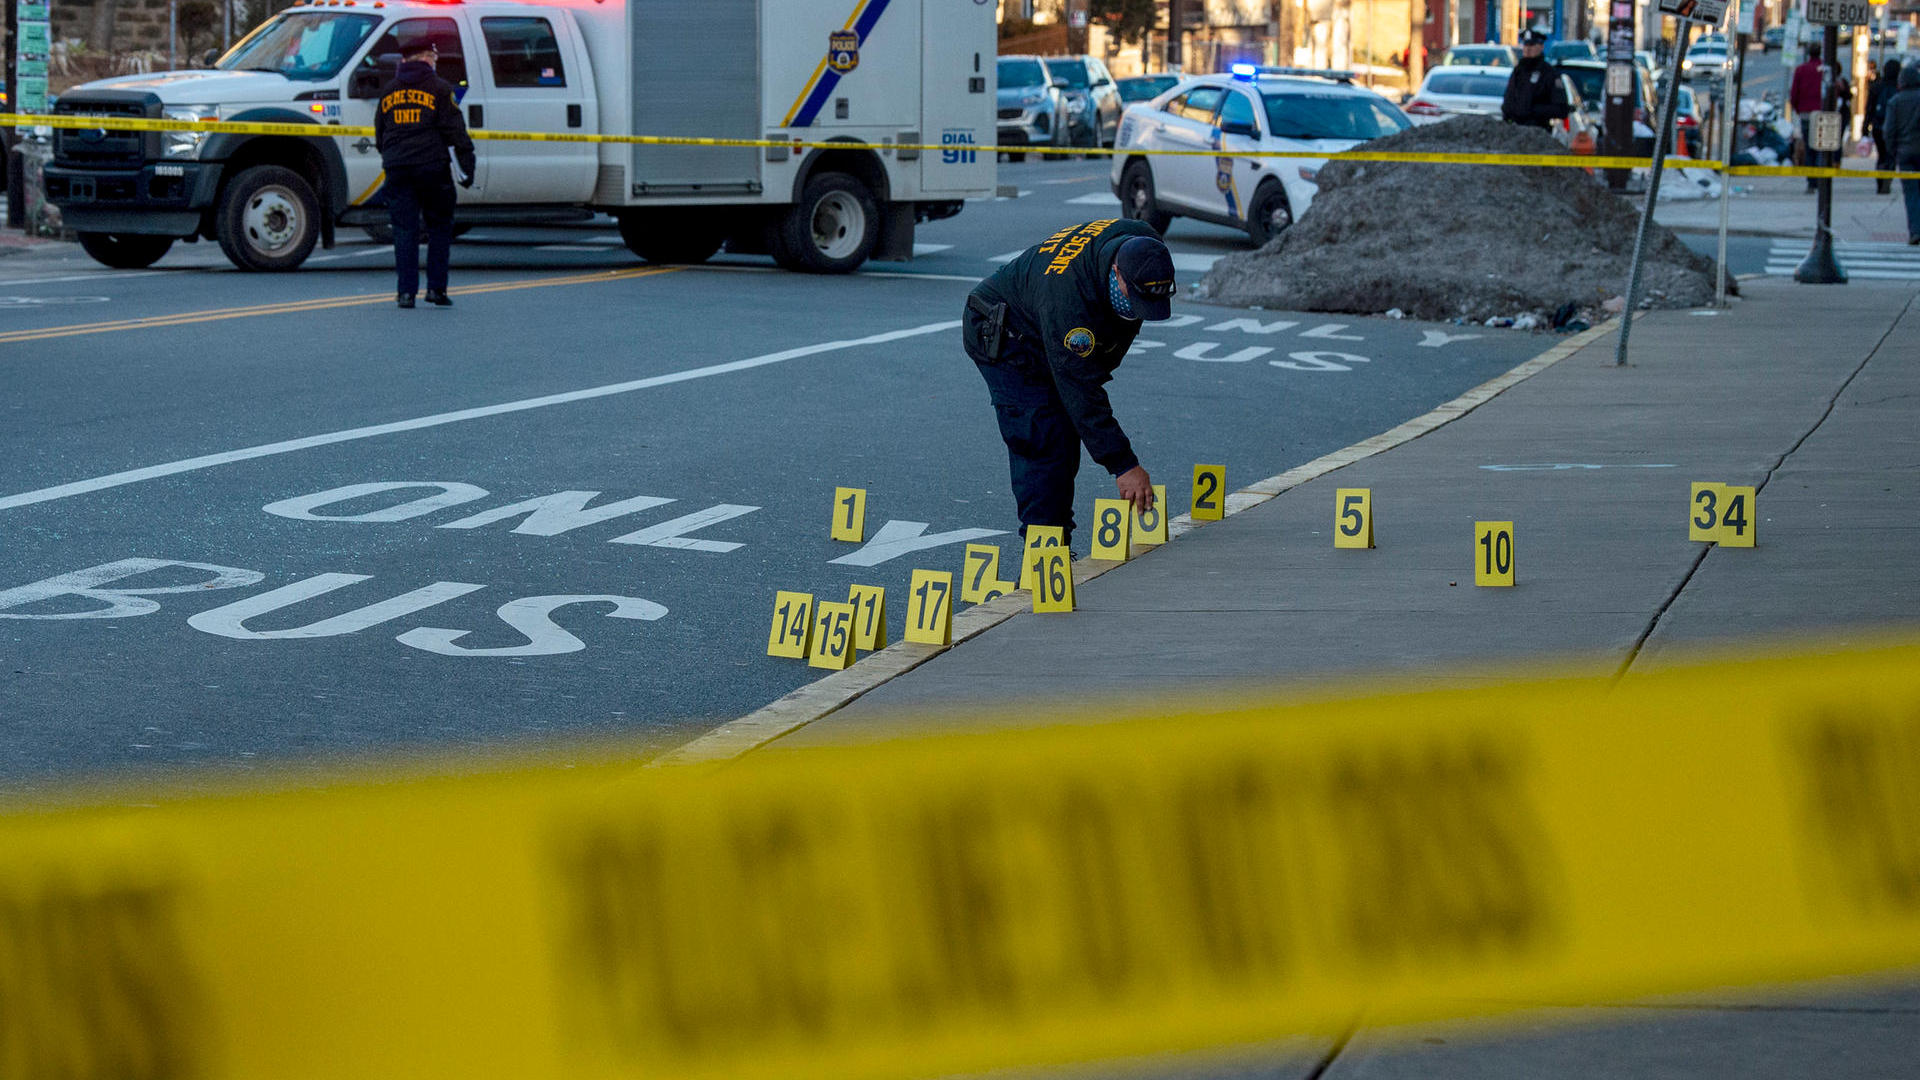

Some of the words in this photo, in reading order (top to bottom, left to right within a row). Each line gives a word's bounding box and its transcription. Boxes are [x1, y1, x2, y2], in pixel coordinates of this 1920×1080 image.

[1812, 1, 1834, 19] THE
[1840, 4, 1865, 20] BOX
[381, 89, 407, 114] CRME
[407, 89, 436, 111] SCENE
[393, 108, 422, 124] UNIT
[942, 133, 976, 144] DIAL
[942, 145, 976, 164] 911
[1044, 235, 1091, 275] SCENE
[1195, 471, 1217, 509] 2
[1693, 490, 1718, 529] 3
[262, 481, 1012, 566] ONLY
[842, 493, 857, 529] 1
[1098, 508, 1122, 548] 8
[1340, 495, 1363, 536] 5
[1722, 495, 1747, 536] 4
[970, 551, 994, 591] 7
[1480, 530, 1511, 575] 10
[1033, 555, 1066, 603] 16
[0, 557, 669, 657] BUS
[778, 601, 807, 646] 14
[850, 591, 877, 636] 11
[916, 580, 948, 631] 17
[820, 611, 850, 657] 15
